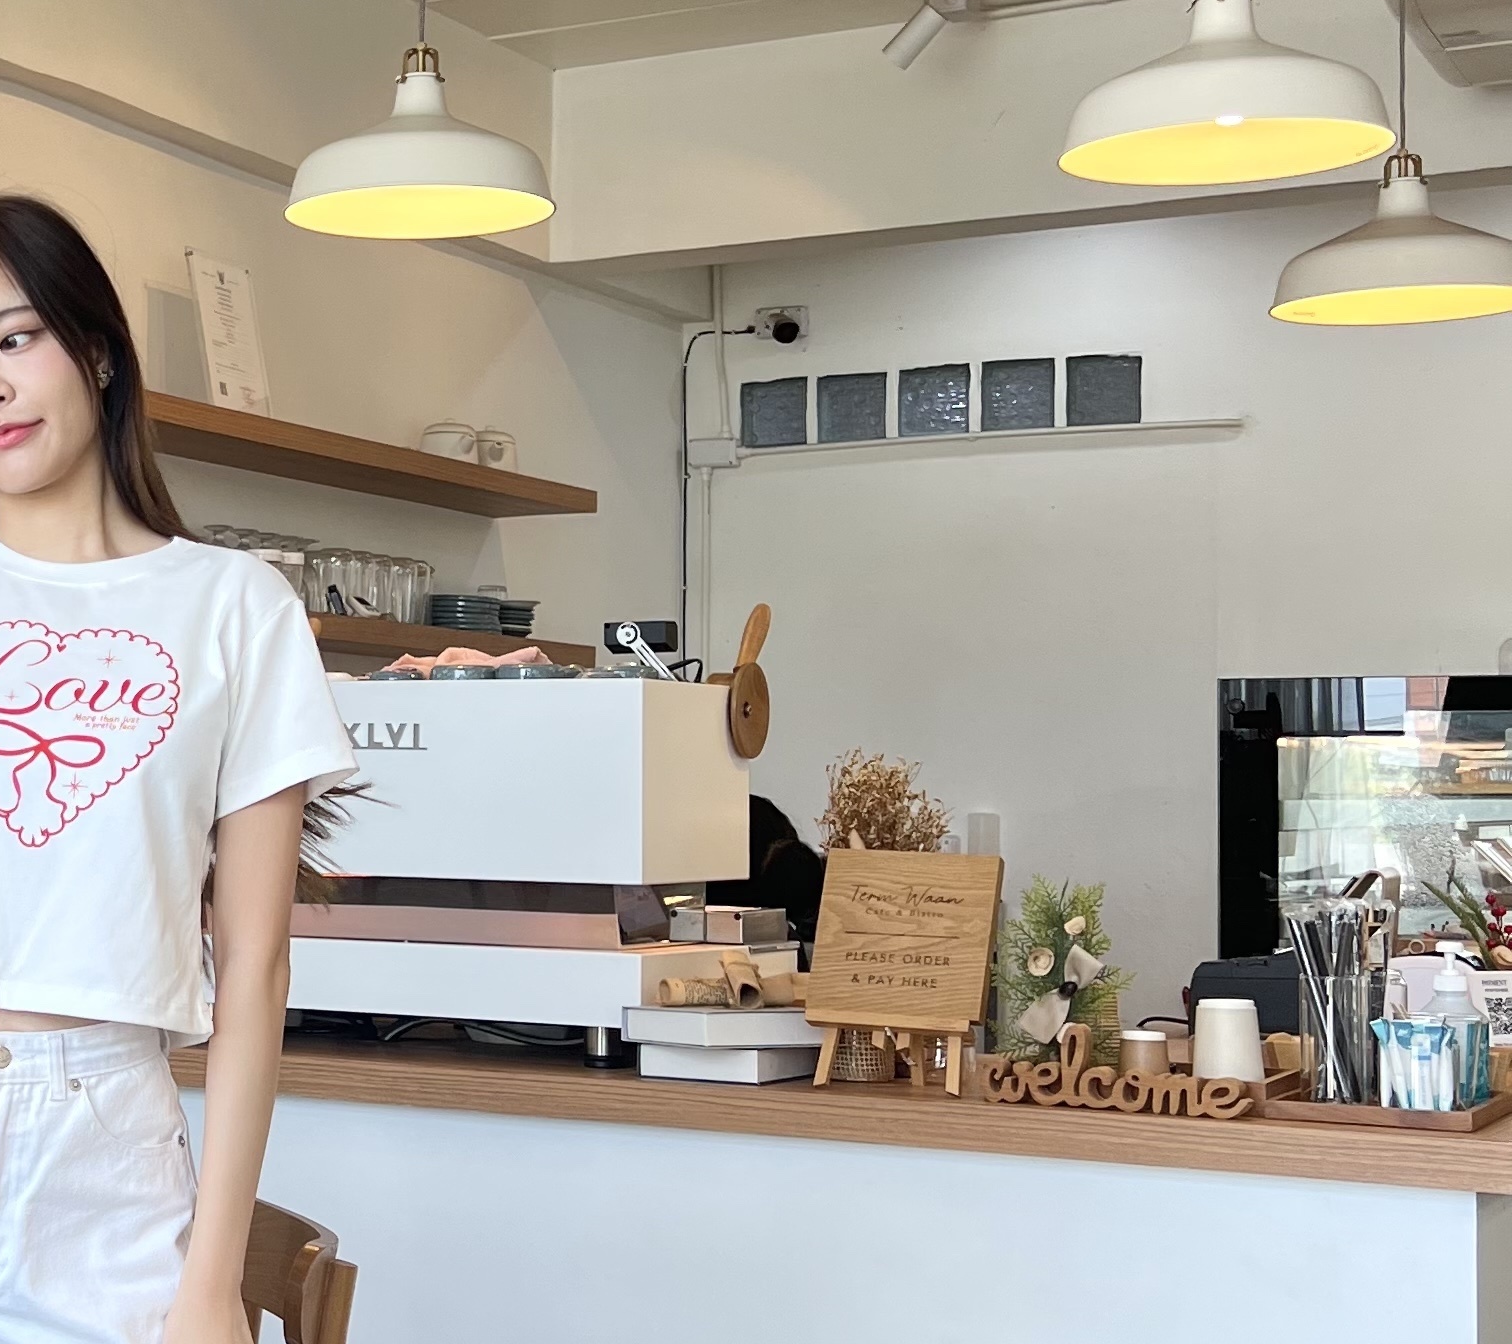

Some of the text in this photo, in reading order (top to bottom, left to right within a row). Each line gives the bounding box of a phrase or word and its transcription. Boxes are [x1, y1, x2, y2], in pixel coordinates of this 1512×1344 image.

[100, 714, 120, 723] than
[123, 716, 140, 725] just
[901, 886, 965, 907] Waan
[910, 909, 944, 918] Bistro
[845, 951, 951, 966] PLEASE ORDER
[851, 973, 938, 989] & PAY HERE
[984, 1022, 1254, 1119] welcome
